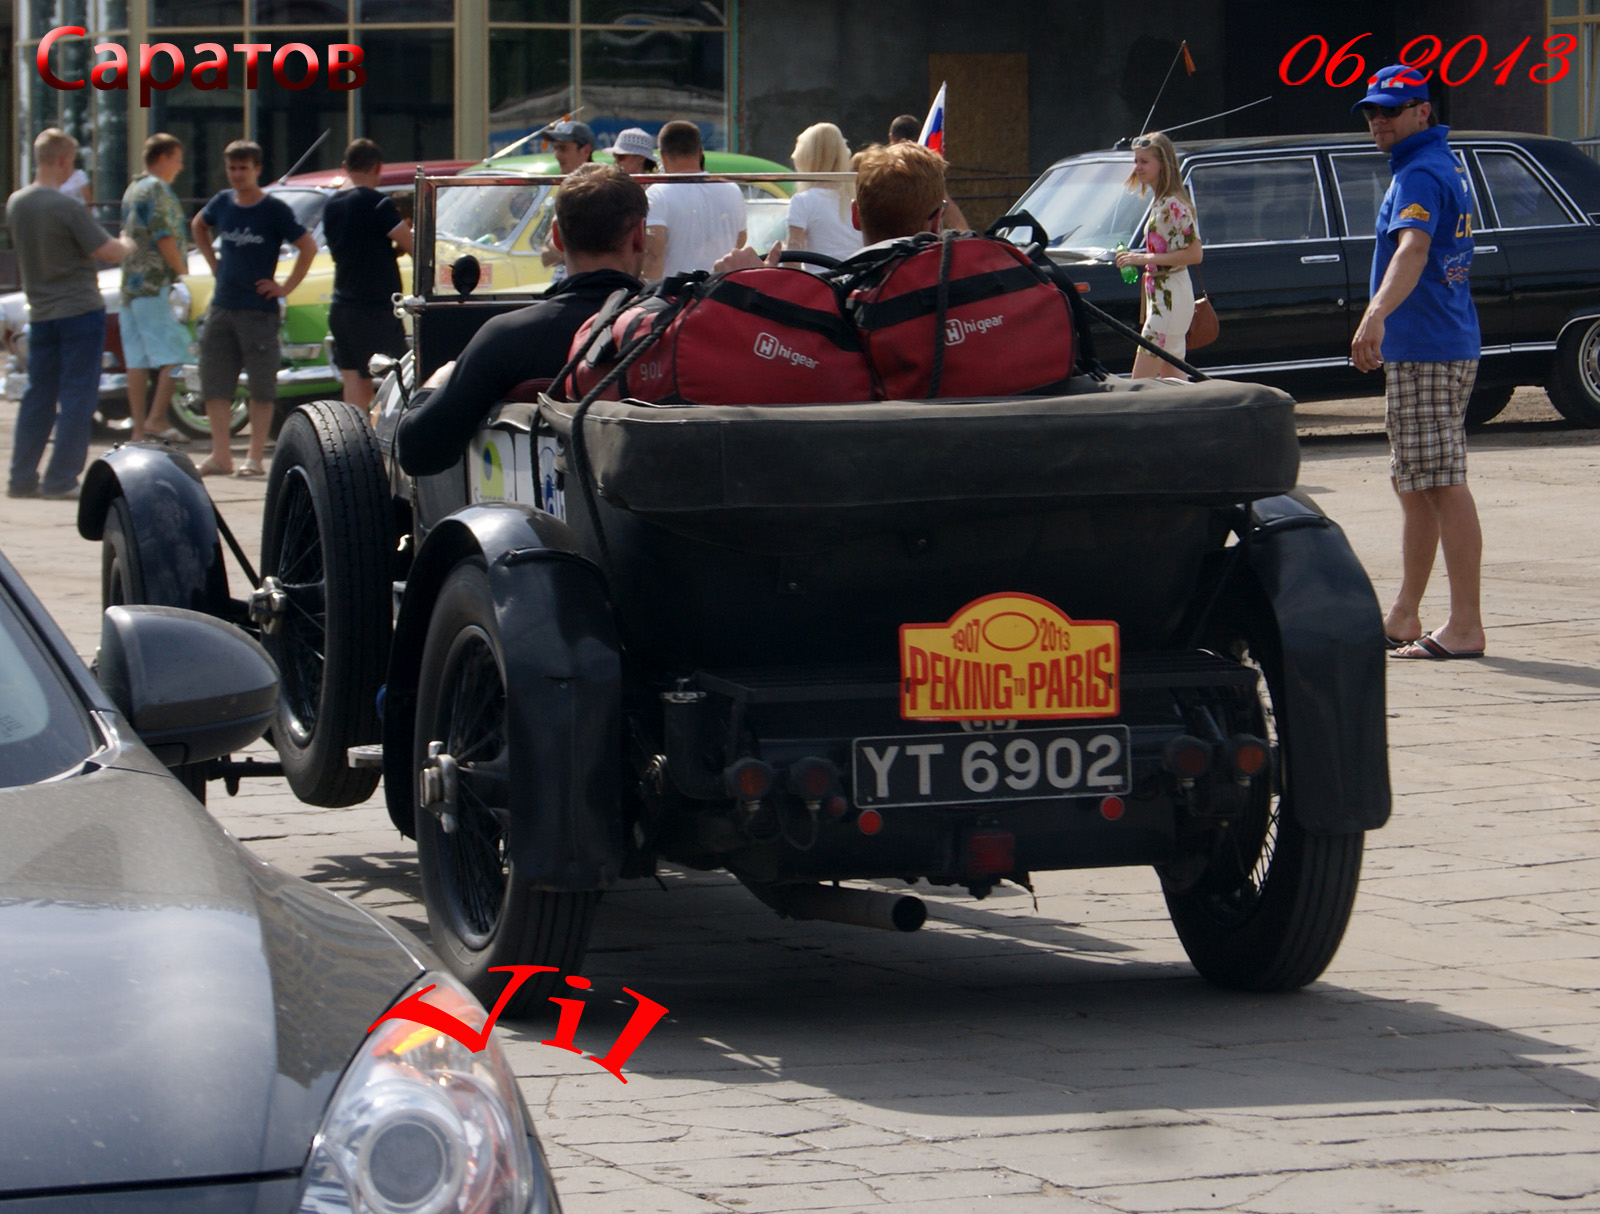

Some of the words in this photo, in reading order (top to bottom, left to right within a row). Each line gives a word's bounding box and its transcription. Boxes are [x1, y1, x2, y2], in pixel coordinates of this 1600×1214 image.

[951, 618, 980, 653] 1907
[1039, 617, 1071, 652] 2013
[908, 645, 1013, 711] PEKING
[1027, 642, 1112, 709] PARIS
[862, 743, 945, 798] YT
[961, 734, 1124, 793] 6902
